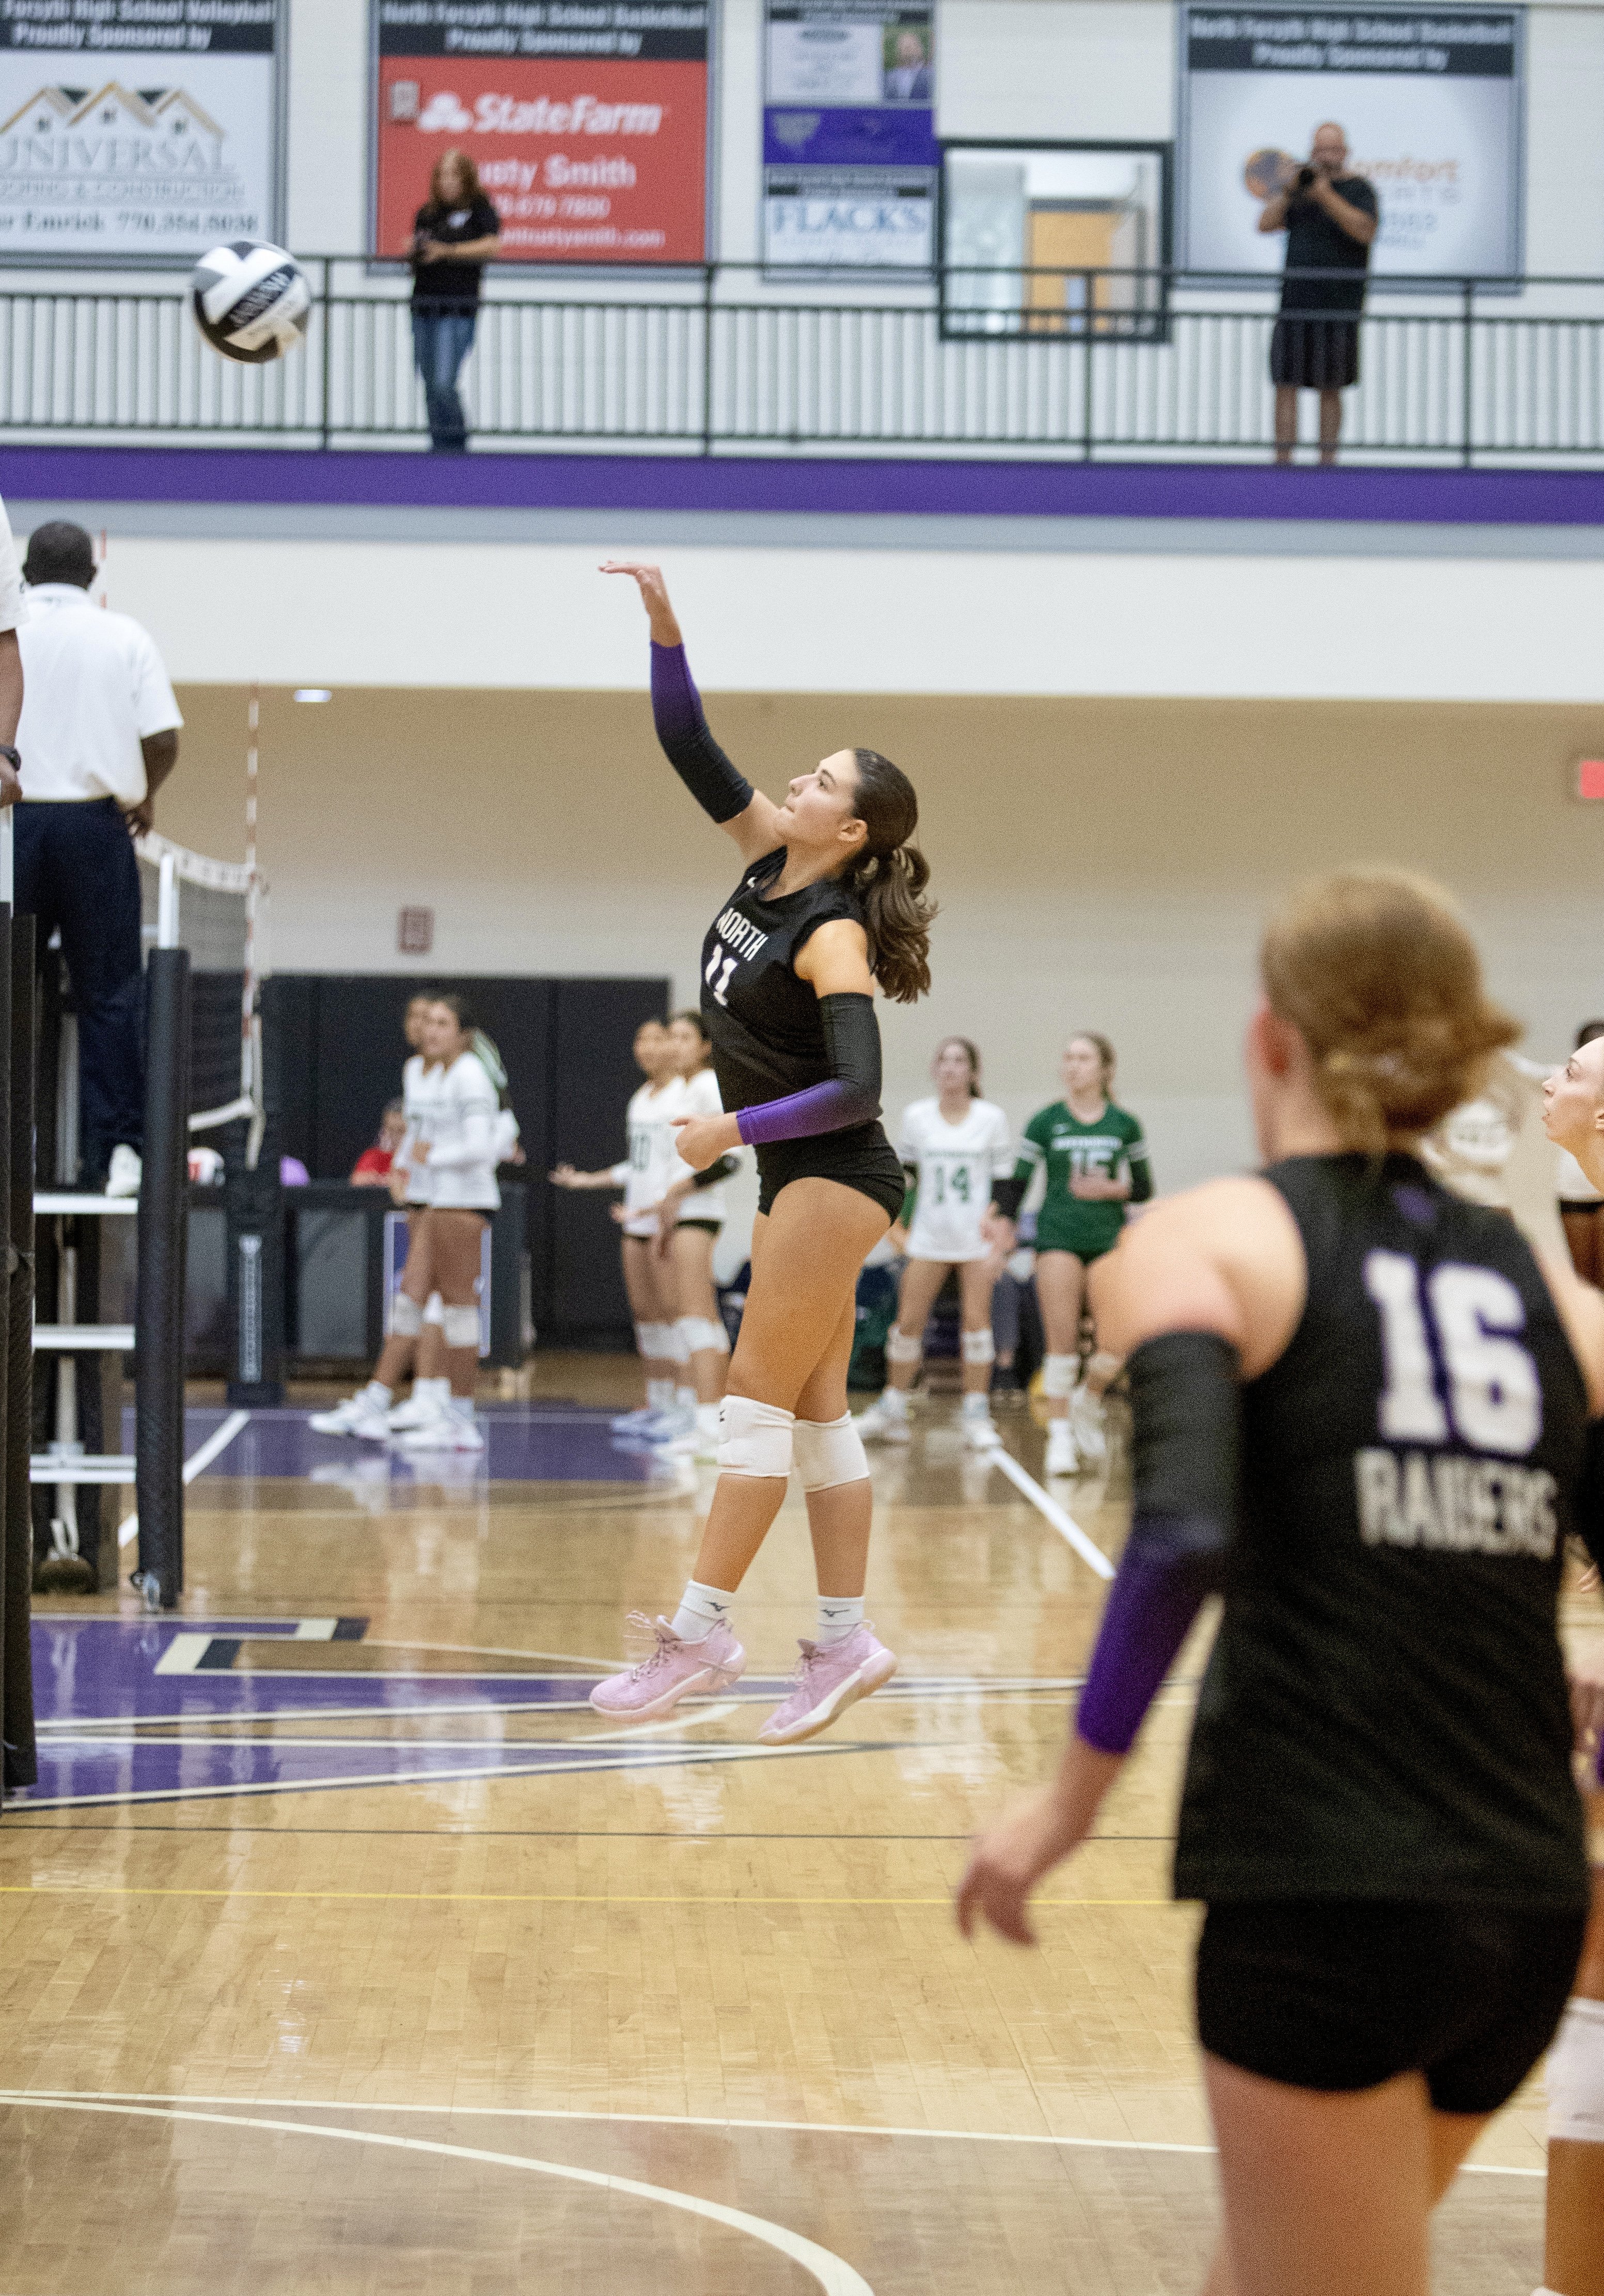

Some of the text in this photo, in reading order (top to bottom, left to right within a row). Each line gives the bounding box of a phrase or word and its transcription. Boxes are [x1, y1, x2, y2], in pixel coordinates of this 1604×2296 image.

[14, 22, 85, 48] Proudly
[89, 23, 185, 46] Sponsored
[447, 28, 517, 51] Proudly
[521, 30, 617, 52] Sponsored
[544, 153, 637, 188] Smith
[1350, 153, 1459, 184] omfort
[716, 908, 769, 961] NORTH
[705, 944, 738, 1007] 11
[934, 1165, 970, 1204] 14
[1362, 1247, 1544, 1458] 16
[1353, 1447, 1559, 1562] RAIDERS
